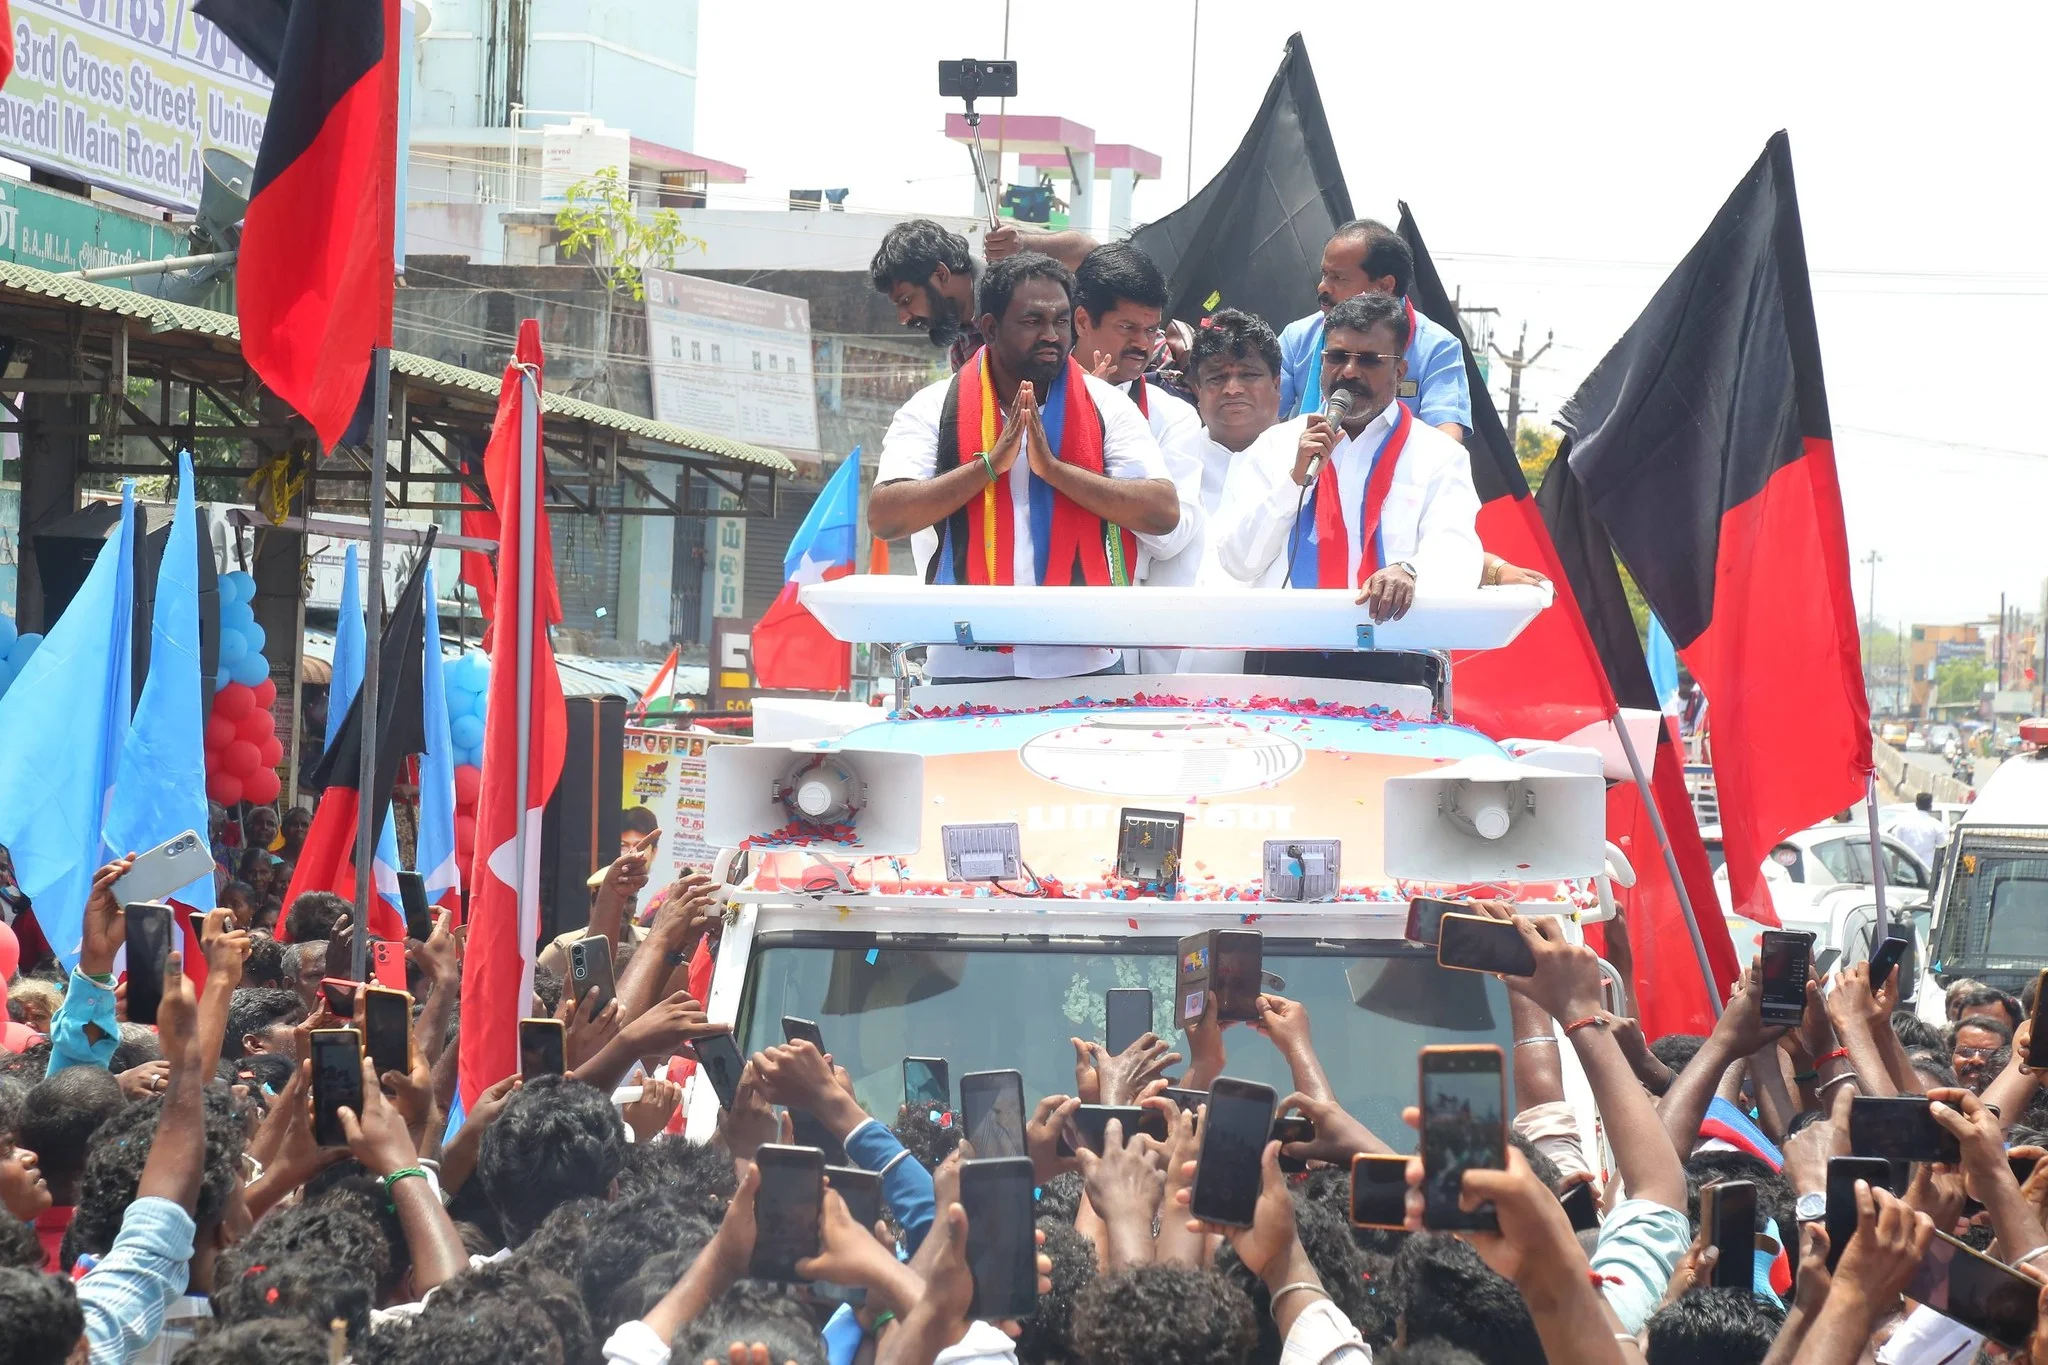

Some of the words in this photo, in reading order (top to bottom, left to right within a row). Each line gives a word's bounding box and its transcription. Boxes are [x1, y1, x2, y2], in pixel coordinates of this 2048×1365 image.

[16, 23, 56, 82] 3rd
[62, 40, 124, 105] Cross
[129, 65, 202, 143] Street,
[208, 92, 267, 151] Unive
[64, 106, 120, 170] Main
